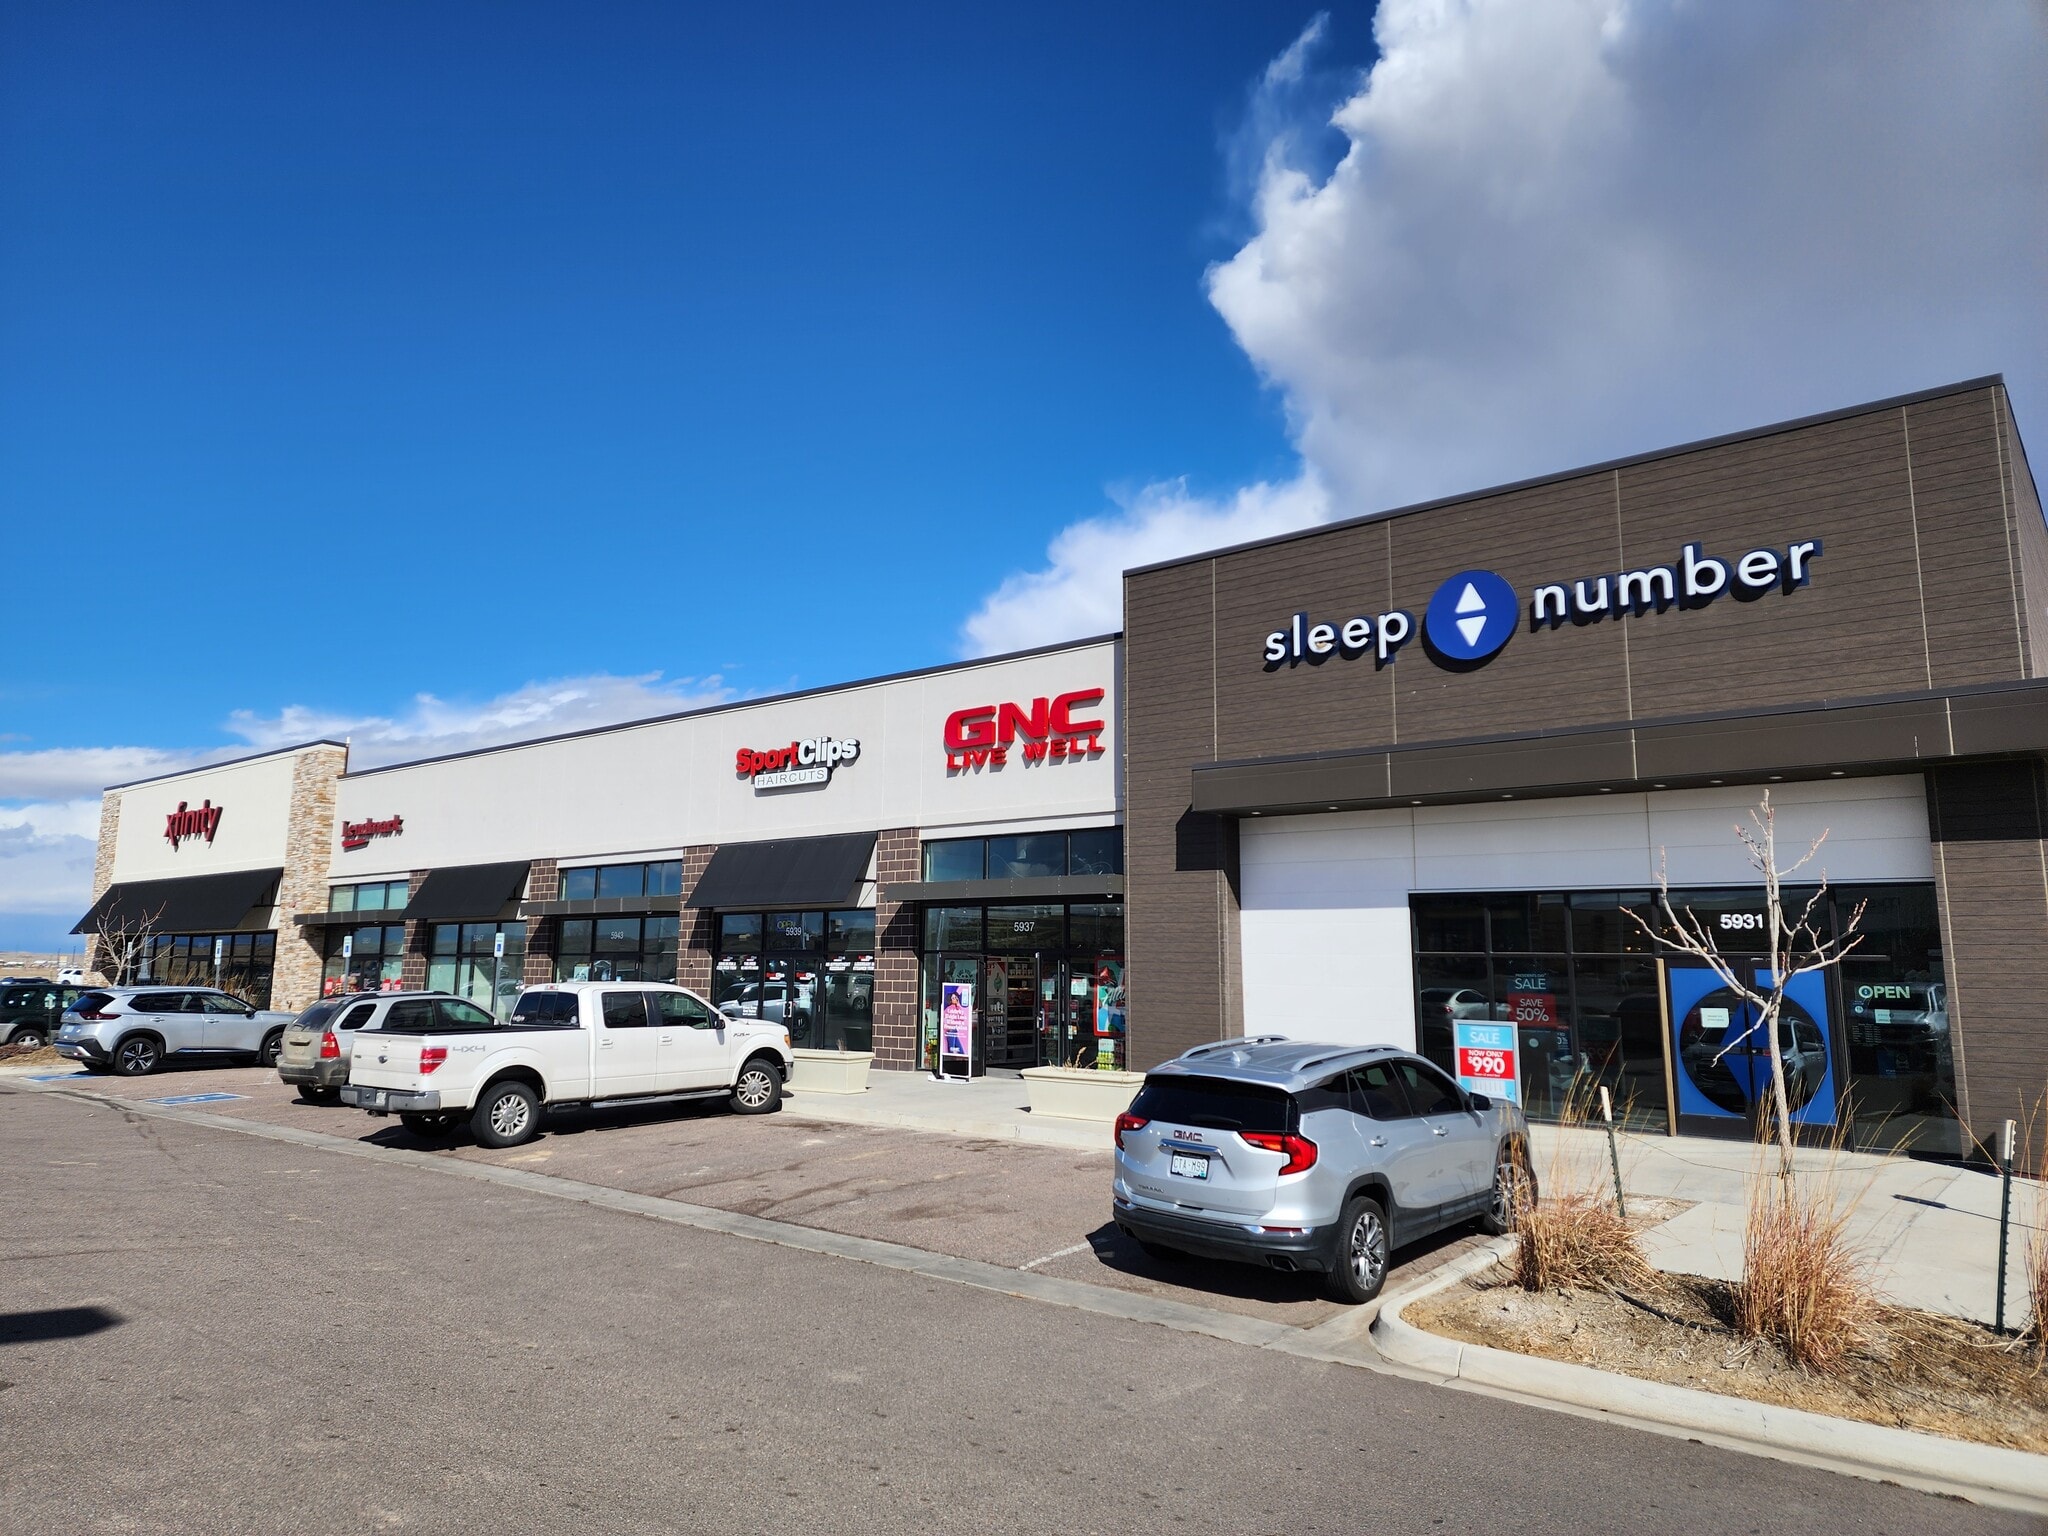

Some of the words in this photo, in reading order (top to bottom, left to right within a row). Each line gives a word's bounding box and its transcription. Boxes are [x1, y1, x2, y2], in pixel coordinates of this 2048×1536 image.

[1264, 613, 1412, 661] sleep
[1533, 543, 1816, 621] number
[944, 688, 1105, 749] GNC
[735, 736, 858, 777] SportClips
[946, 747, 1007, 769] LIVE
[1023, 734, 1105, 760] WELL
[757, 769, 825, 786] HAIRCUTS
[163, 799, 223, 846] xfinity
[1013, 921, 1035, 932] 5937
[1720, 913, 1764, 929] 5931
[610, 931, 624, 940] 5943
[785, 927, 802, 937] 5939
[1514, 978, 1547, 990] SALE
[1858, 985, 1910, 999] OPEN
[1520, 998, 1544, 1007] SAVE
[1515, 1008, 1550, 1022] 50%
[1469, 1032, 1500, 1044] SALE
[1467, 1056, 1505, 1074] $990
[1173, 1129, 1203, 1143] GMC
